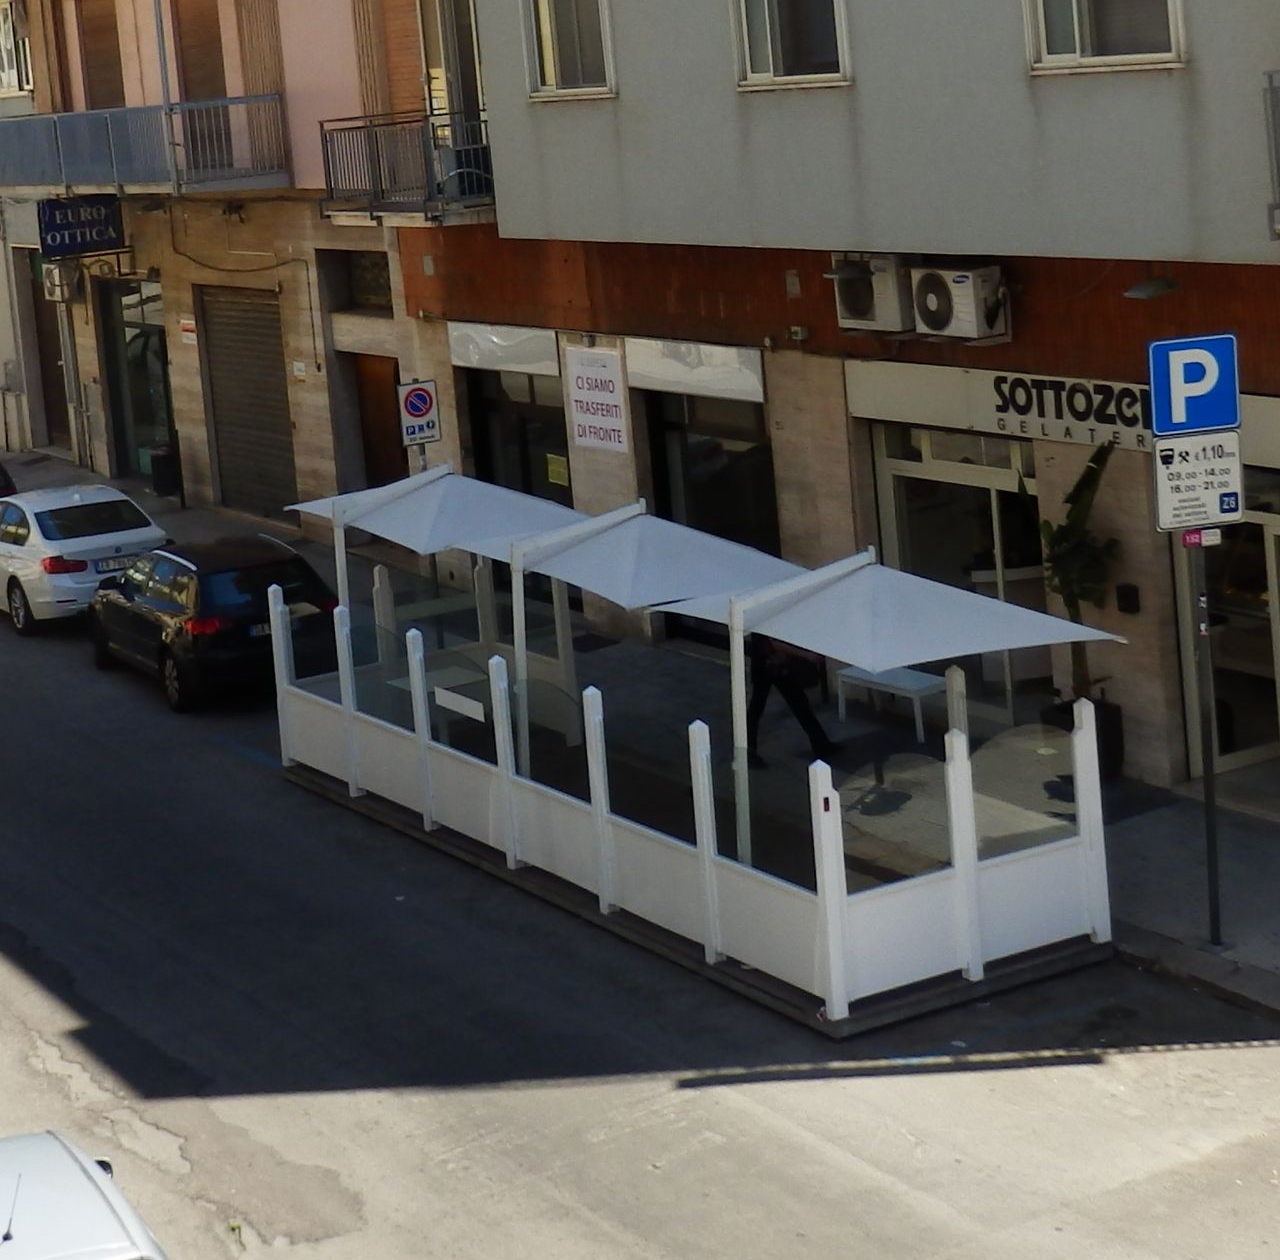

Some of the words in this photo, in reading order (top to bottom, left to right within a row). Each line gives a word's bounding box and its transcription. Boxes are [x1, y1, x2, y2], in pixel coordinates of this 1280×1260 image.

[55, 205, 106, 224] EURO
[46, 226, 117, 246] OTTICA
[576, 375, 585, 391] CI
[586, 376, 615, 394] SIAMO
[1168, 348, 1219, 424] P
[574, 399, 623, 420] TRASFERITI
[577, 424, 587, 438] DI
[588, 425, 623, 444] FRONTE
